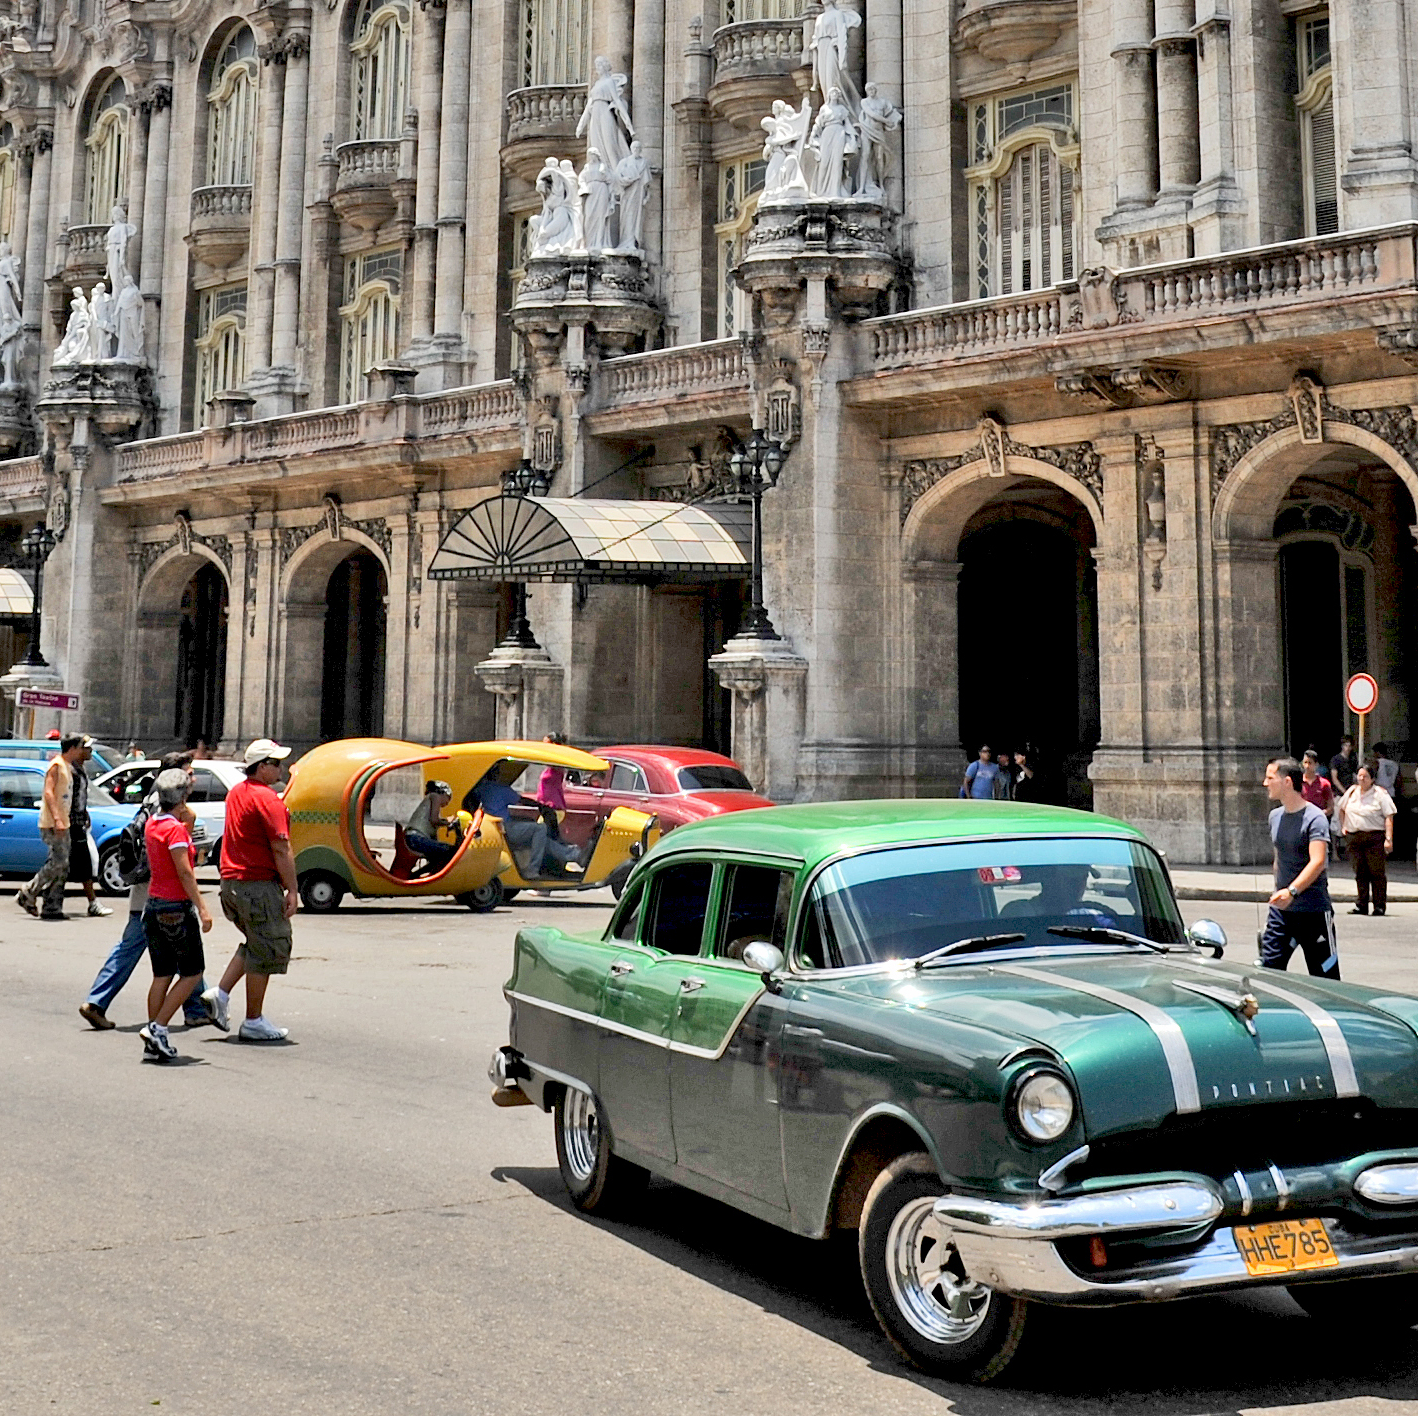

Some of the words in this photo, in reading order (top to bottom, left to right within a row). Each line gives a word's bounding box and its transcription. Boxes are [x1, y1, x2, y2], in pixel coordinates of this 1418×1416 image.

[1212, 1075, 1323, 1099] PONTIAC
[1268, 1223, 1290, 1234] CUBA
[1240, 1229, 1330, 1263] HHE785
